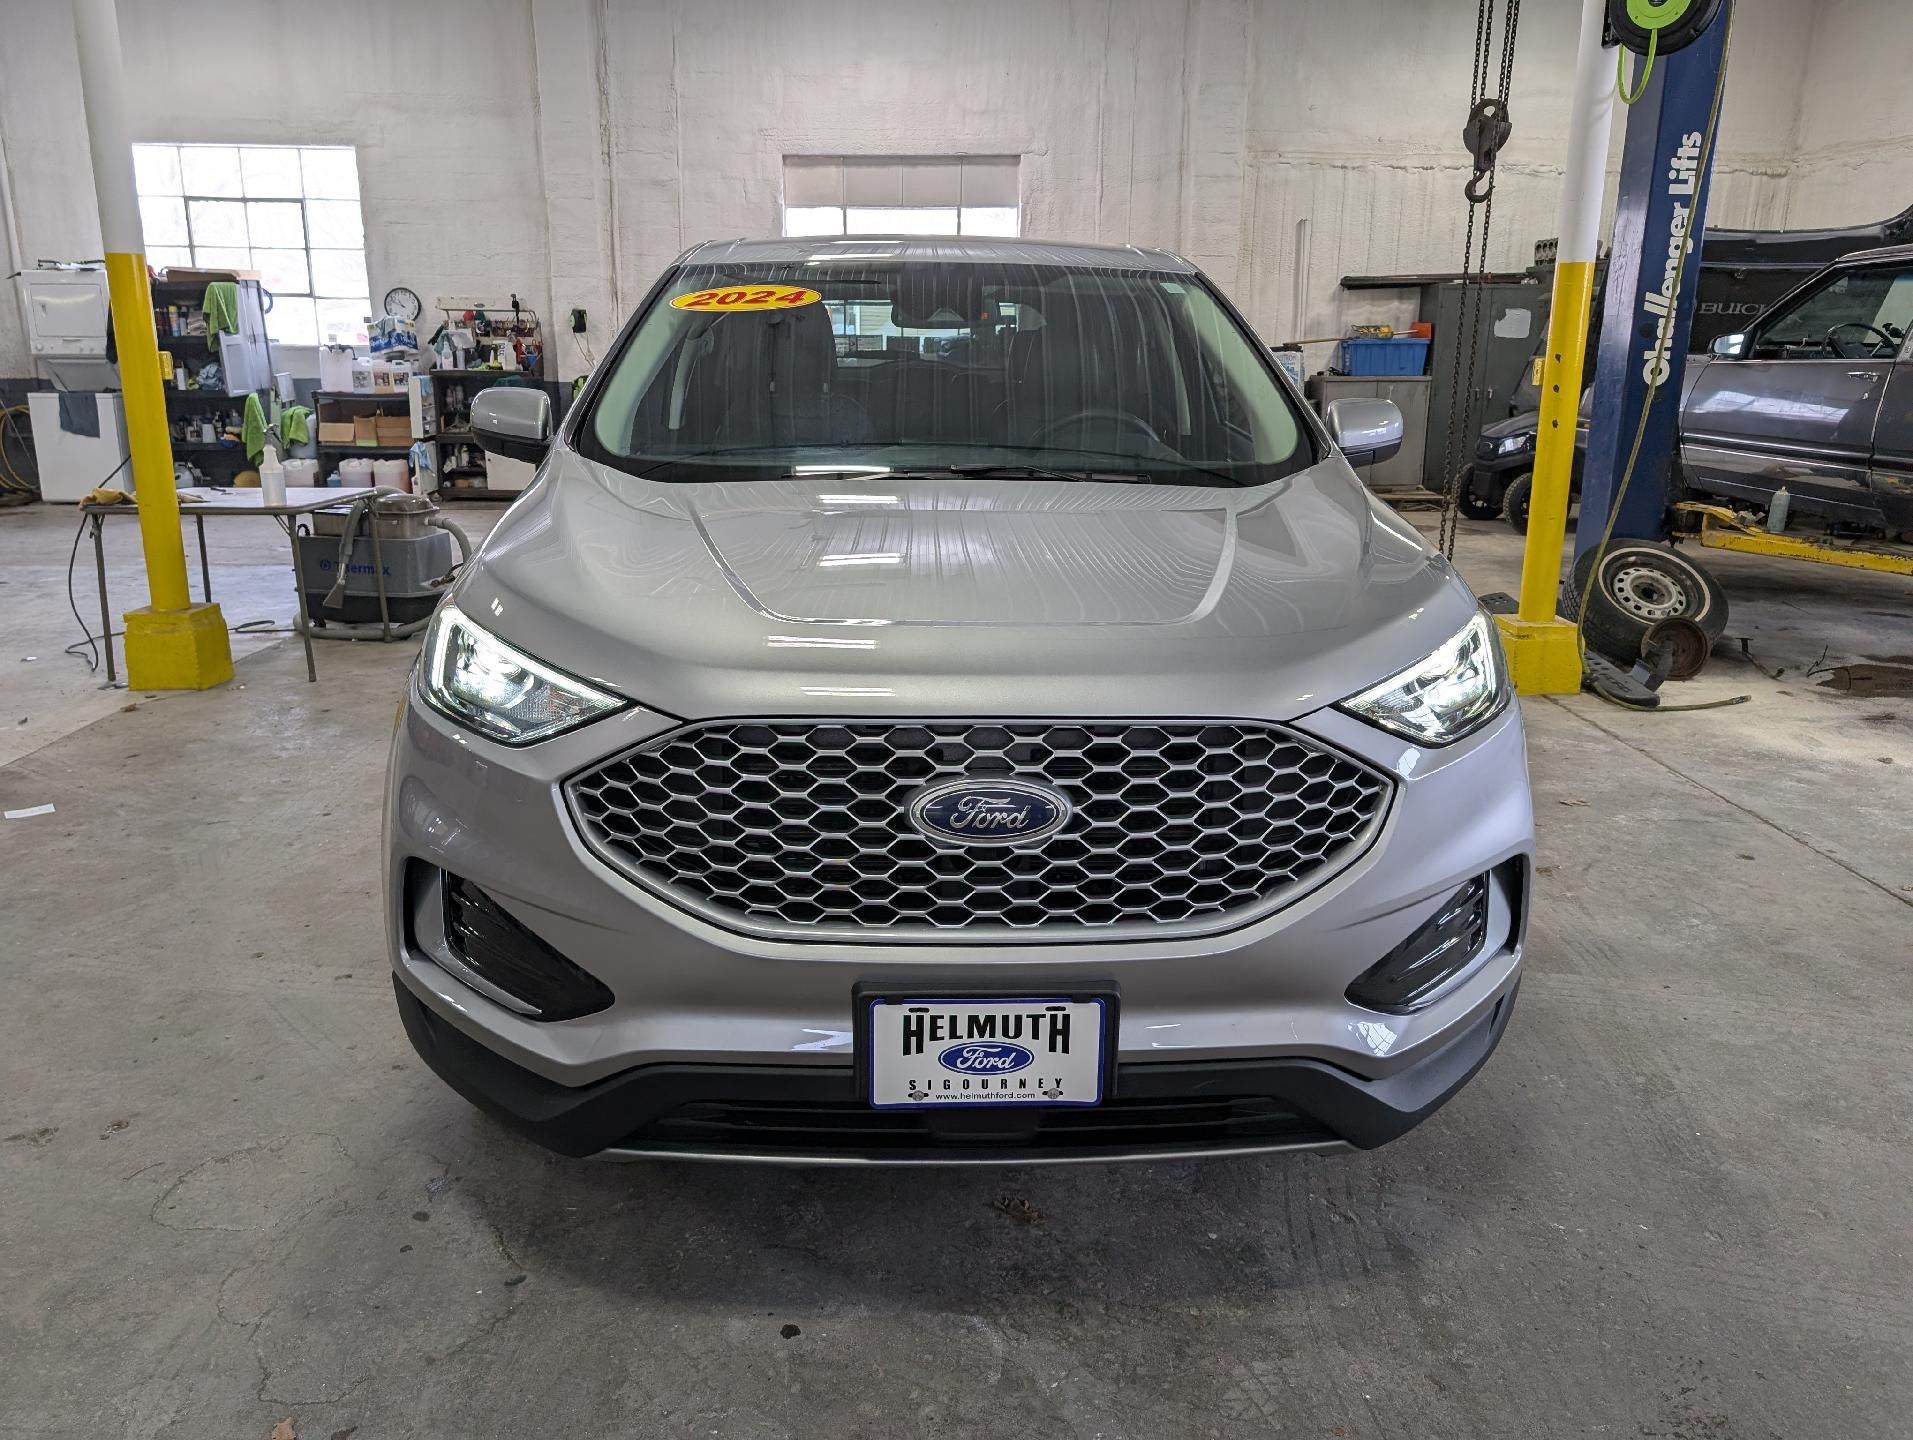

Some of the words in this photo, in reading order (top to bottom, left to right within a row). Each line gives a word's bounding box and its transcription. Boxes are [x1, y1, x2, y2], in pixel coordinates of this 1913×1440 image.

[1642, 202, 1694, 387] Challenger
[1668, 131, 1702, 195] Lifts
[683, 290, 807, 307] 2024
[950, 795, 1032, 829] Ford
[902, 1013, 1071, 1056] HELMUTH
[956, 1046, 1016, 1069] Ford
[909, 1078, 1063, 1091] SIGOURNEY
[935, 1091, 1036, 1101] www.helmuthford.com
